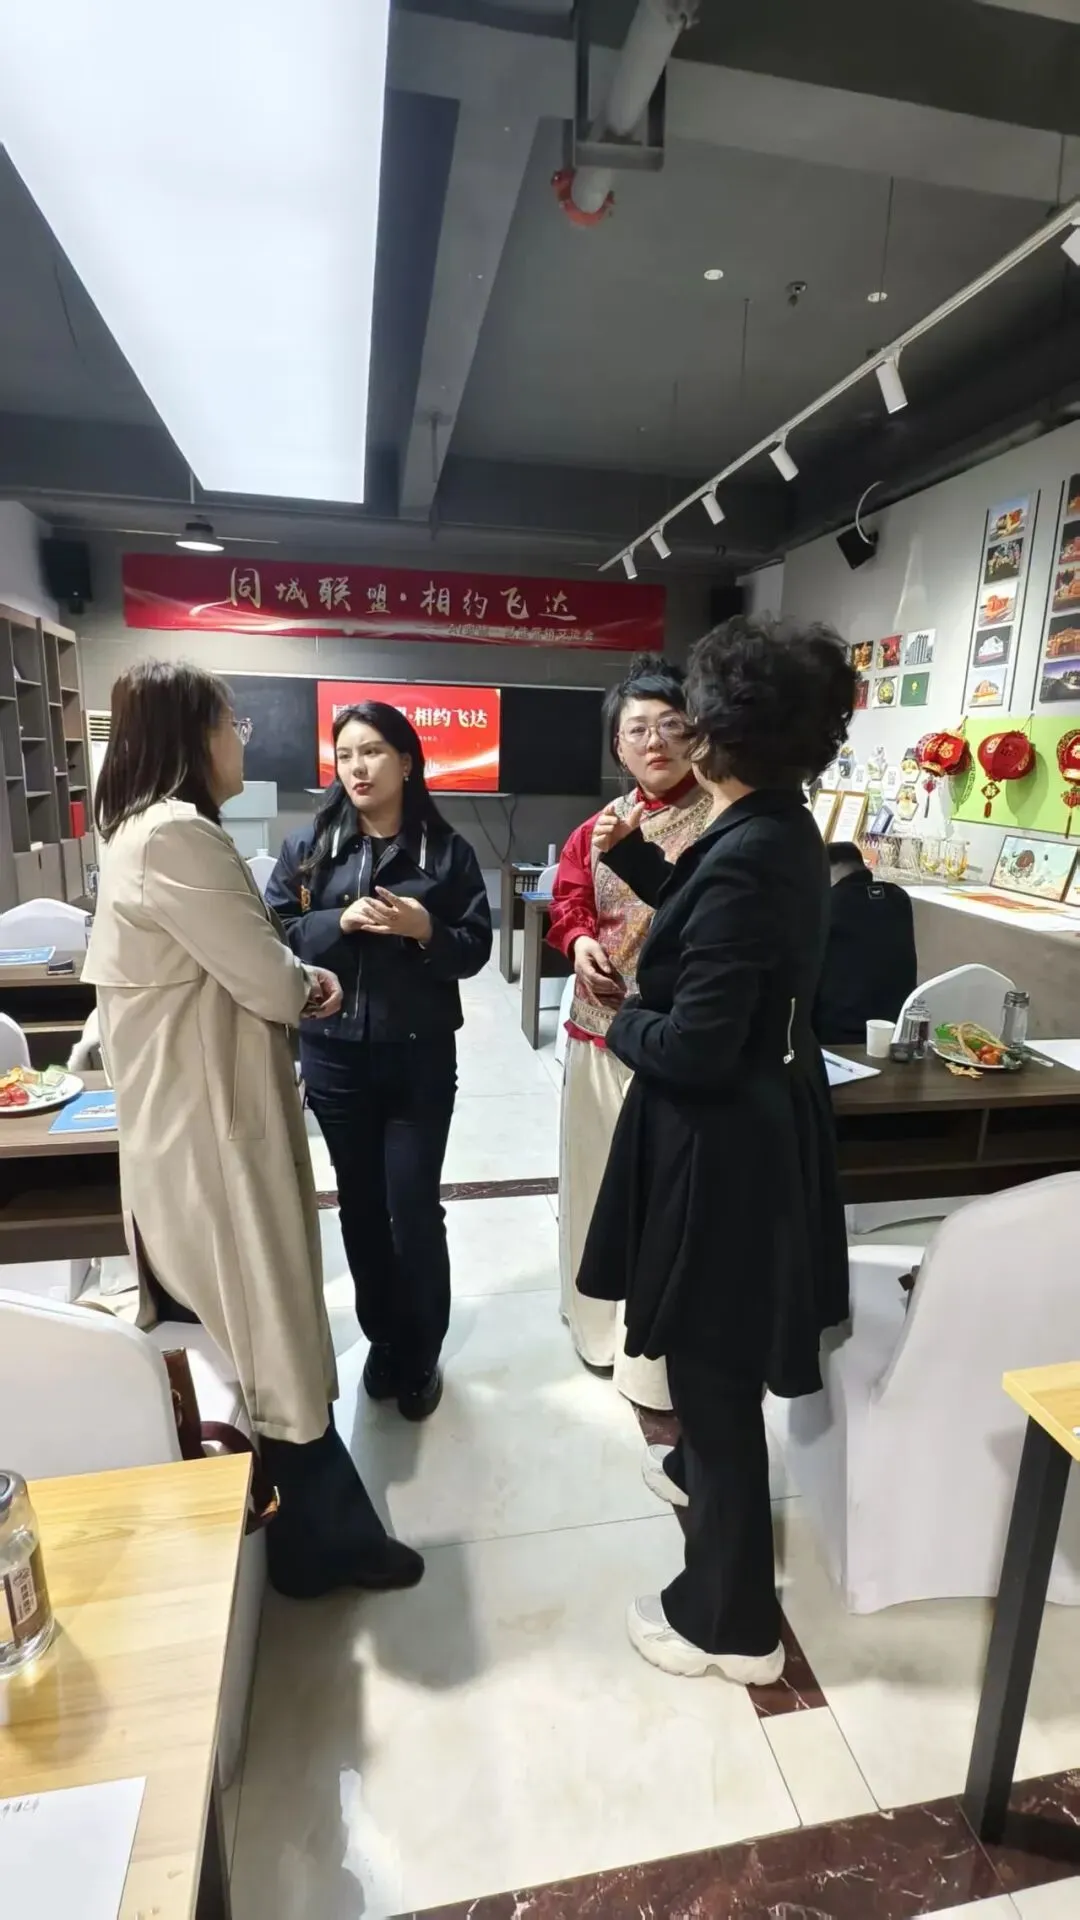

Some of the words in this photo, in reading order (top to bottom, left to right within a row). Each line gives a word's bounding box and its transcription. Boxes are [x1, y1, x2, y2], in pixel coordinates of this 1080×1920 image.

[229, 567, 577, 621] 同城联盟·相约飞达
